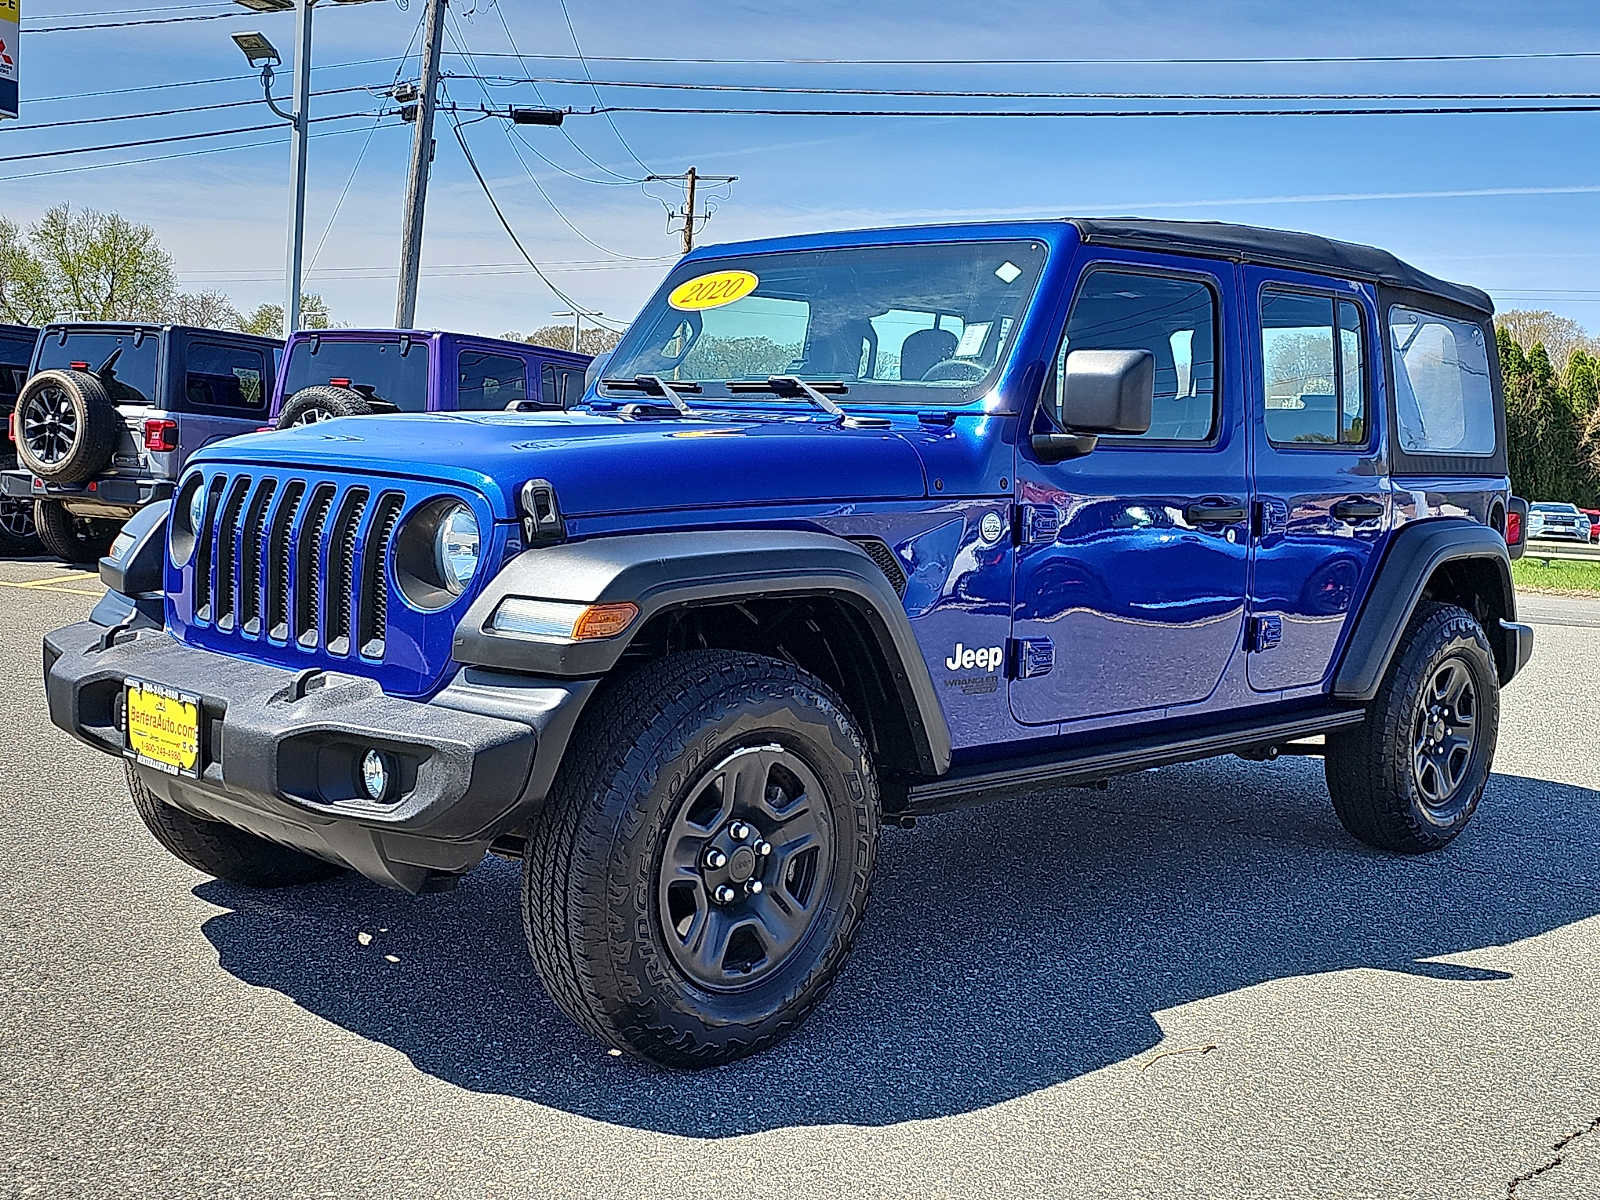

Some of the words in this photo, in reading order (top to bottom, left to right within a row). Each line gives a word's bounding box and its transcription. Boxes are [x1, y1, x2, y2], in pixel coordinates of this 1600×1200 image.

[680, 277, 744, 303] 2020
[946, 643, 1003, 672] Jeep
[944, 676, 998, 688] WRANGLER
